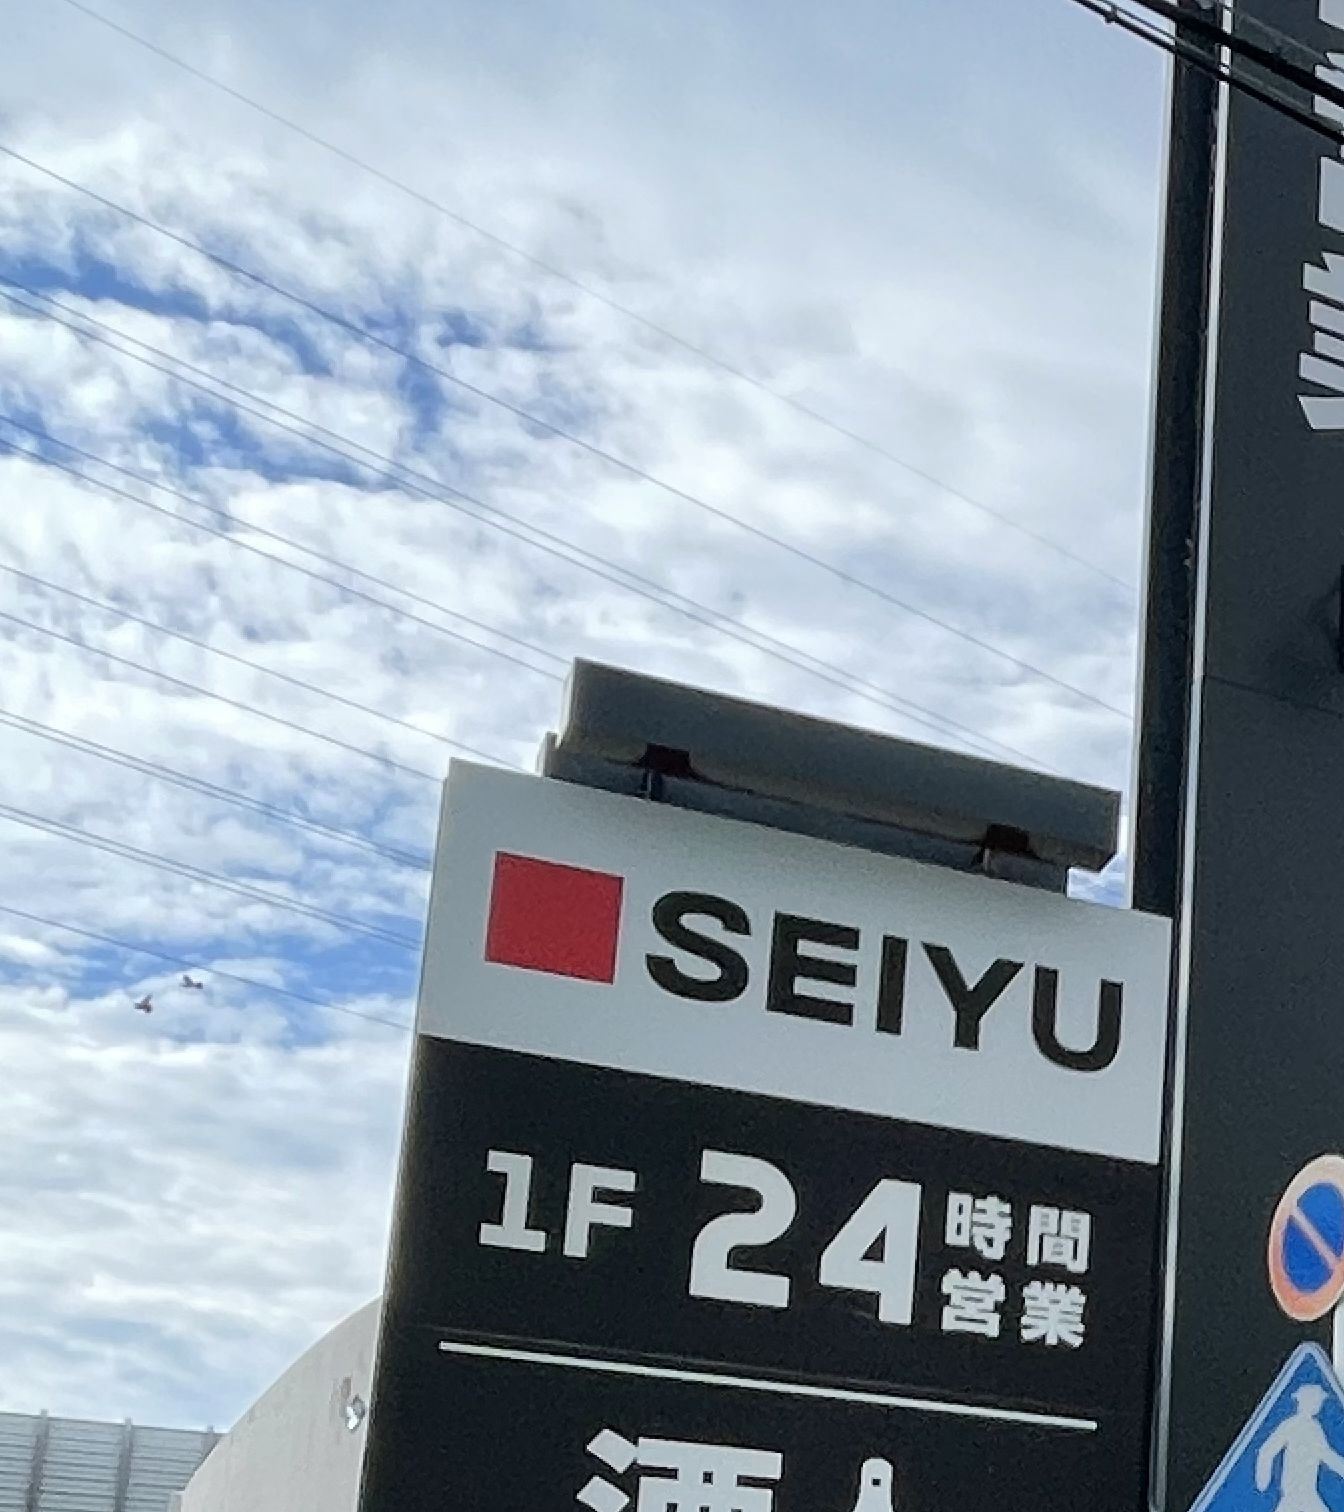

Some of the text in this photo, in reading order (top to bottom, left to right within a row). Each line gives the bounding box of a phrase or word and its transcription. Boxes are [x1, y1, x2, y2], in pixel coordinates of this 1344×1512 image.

[645, 890, 1124, 1072] SEIYU
[480, 1150, 923, 1326] 1F 24
[942, 1190, 1092, 1275] 時間
[940, 1269, 1087, 1348] 営業
